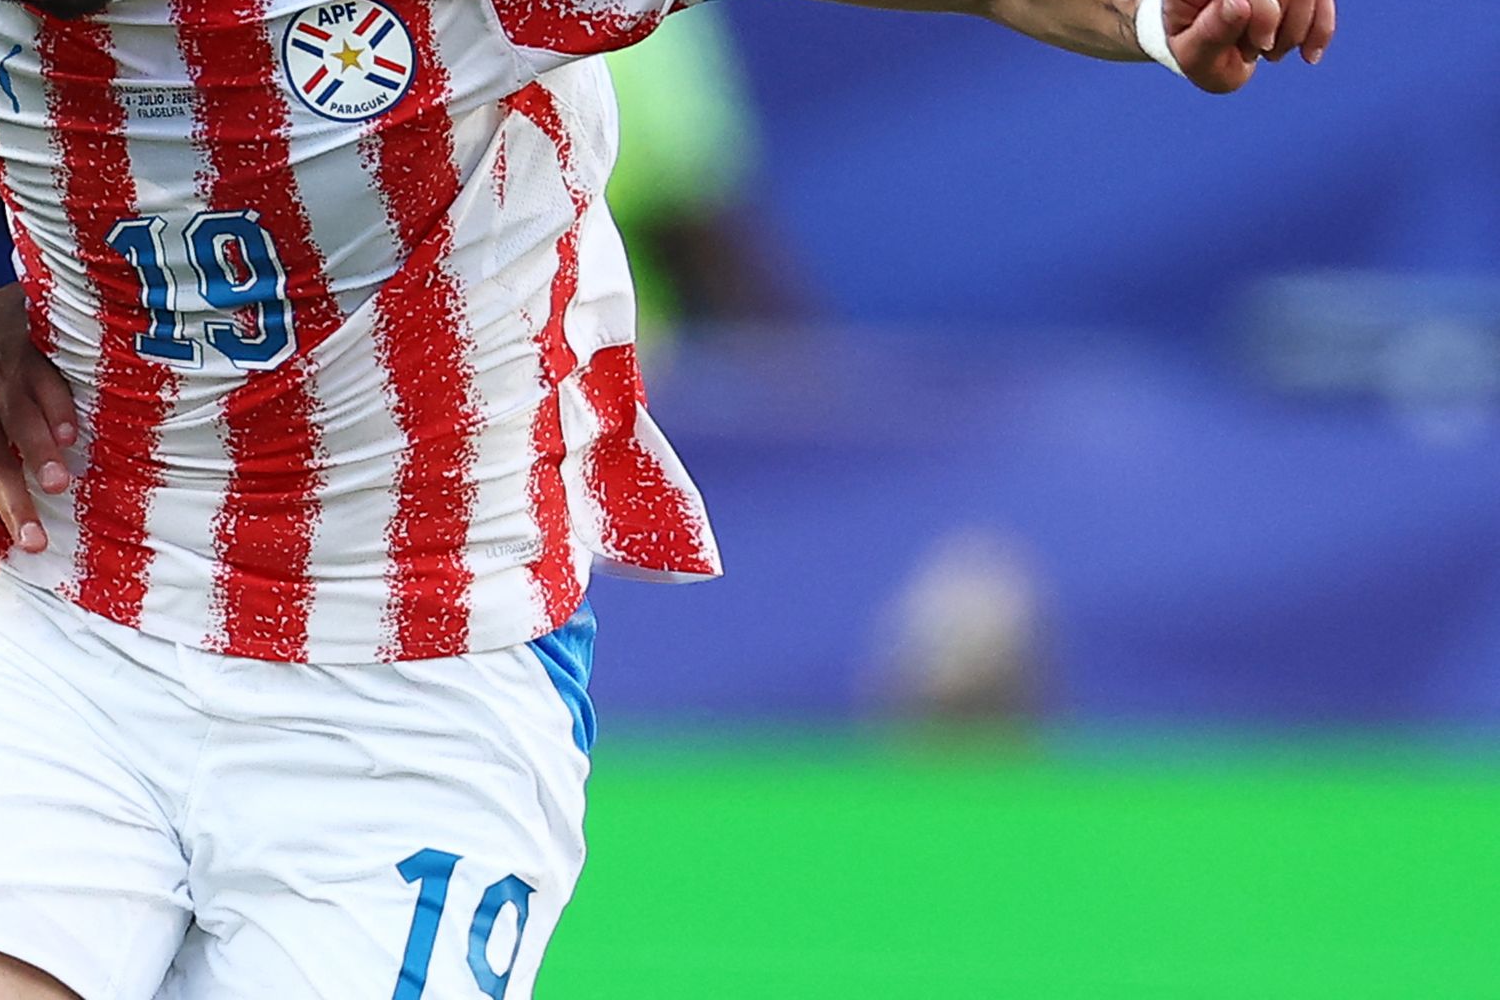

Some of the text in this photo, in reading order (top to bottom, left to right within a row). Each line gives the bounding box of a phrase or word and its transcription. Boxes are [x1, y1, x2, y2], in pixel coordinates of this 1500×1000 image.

[317, 1, 358, 27] APF
[138, 93, 165, 106] JULIO
[329, 91, 390, 115] PARAGUAY
[104, 208, 297, 371] 19
